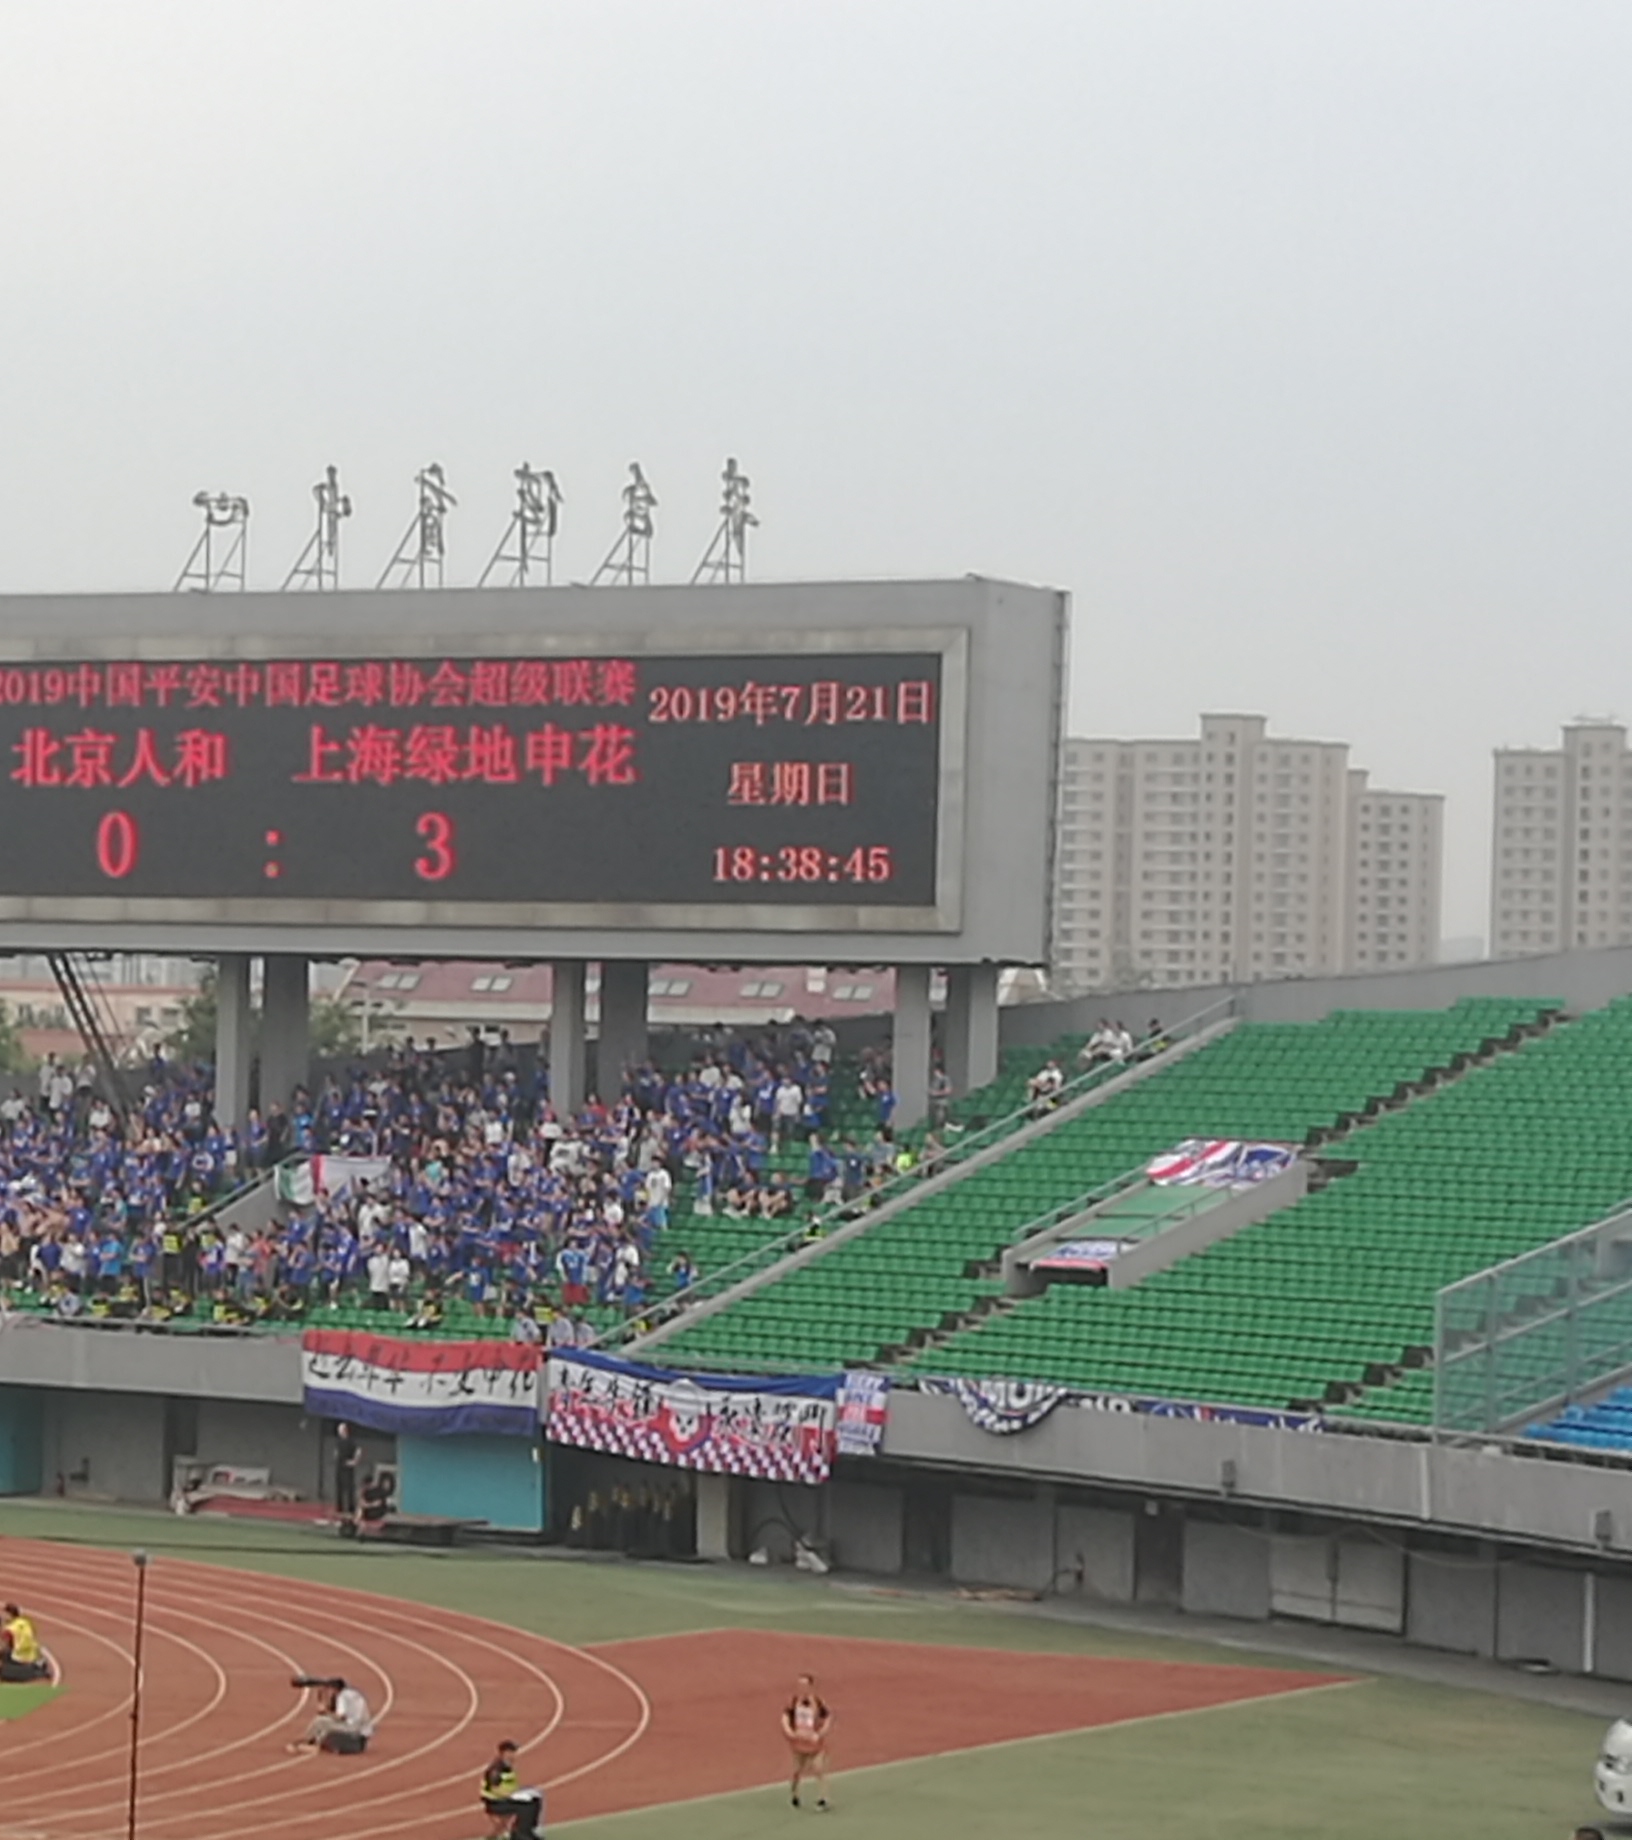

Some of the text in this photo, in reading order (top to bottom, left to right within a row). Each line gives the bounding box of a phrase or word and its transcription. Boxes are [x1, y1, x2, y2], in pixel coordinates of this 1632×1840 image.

[648, 680, 934, 726] 2019年7月21日
[10, 722, 640, 788] 北京人和 上海绿地申花
[727, 761, 854, 806] 星期日
[96, 808, 139, 879] 0
[414, 810, 456, 881] 3
[713, 845, 894, 883] 18:38:45
